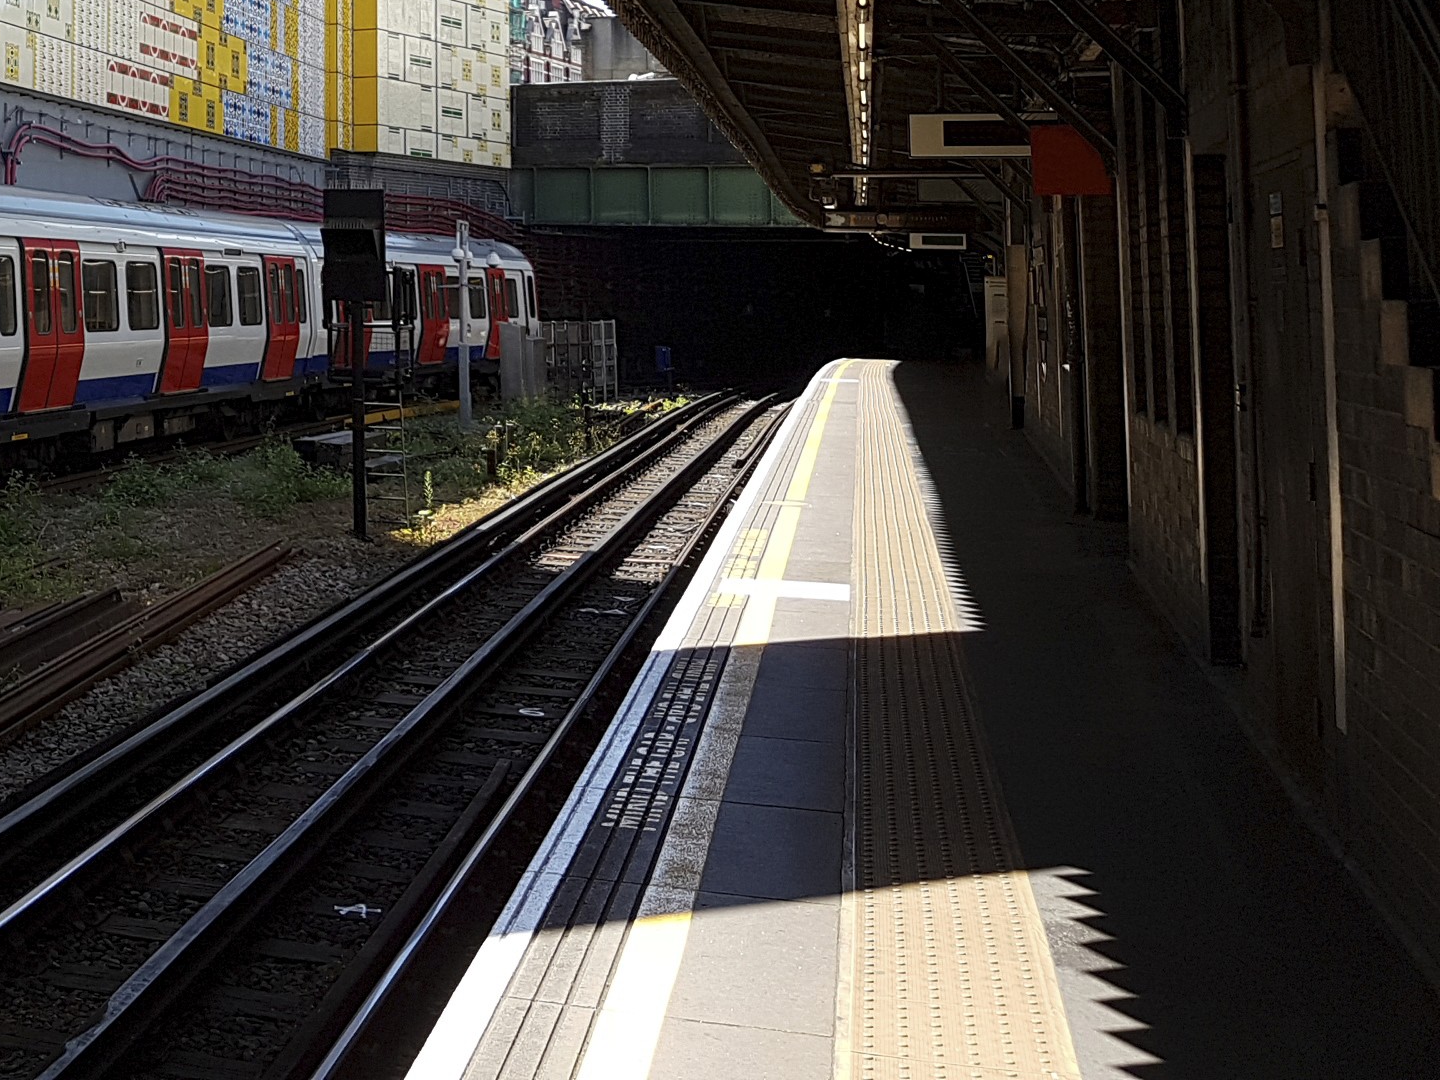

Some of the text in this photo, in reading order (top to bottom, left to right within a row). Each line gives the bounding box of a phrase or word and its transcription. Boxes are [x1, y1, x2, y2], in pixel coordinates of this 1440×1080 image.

[601, 732, 690, 832] MIND THE GAP
